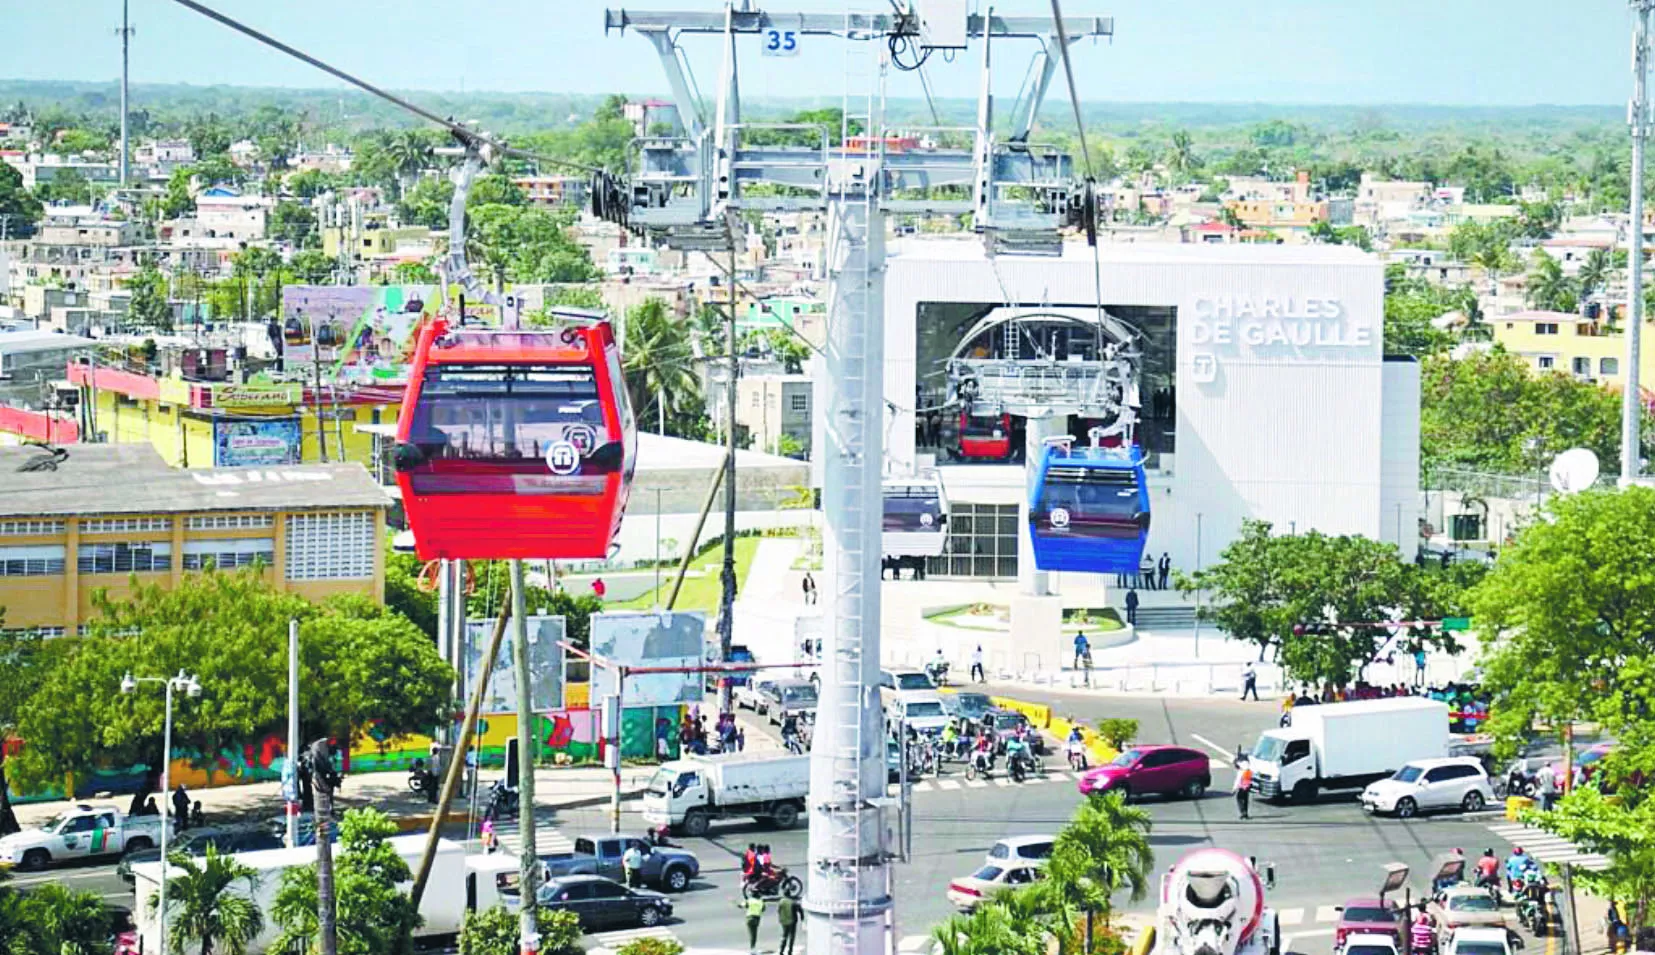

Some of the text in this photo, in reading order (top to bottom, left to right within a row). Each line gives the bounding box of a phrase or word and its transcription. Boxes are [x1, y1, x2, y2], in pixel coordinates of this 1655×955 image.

[768, 31, 796, 50] 35
[1194, 295, 1342, 318] CHARLES
[1191, 320, 1372, 346] DE GAULLE
